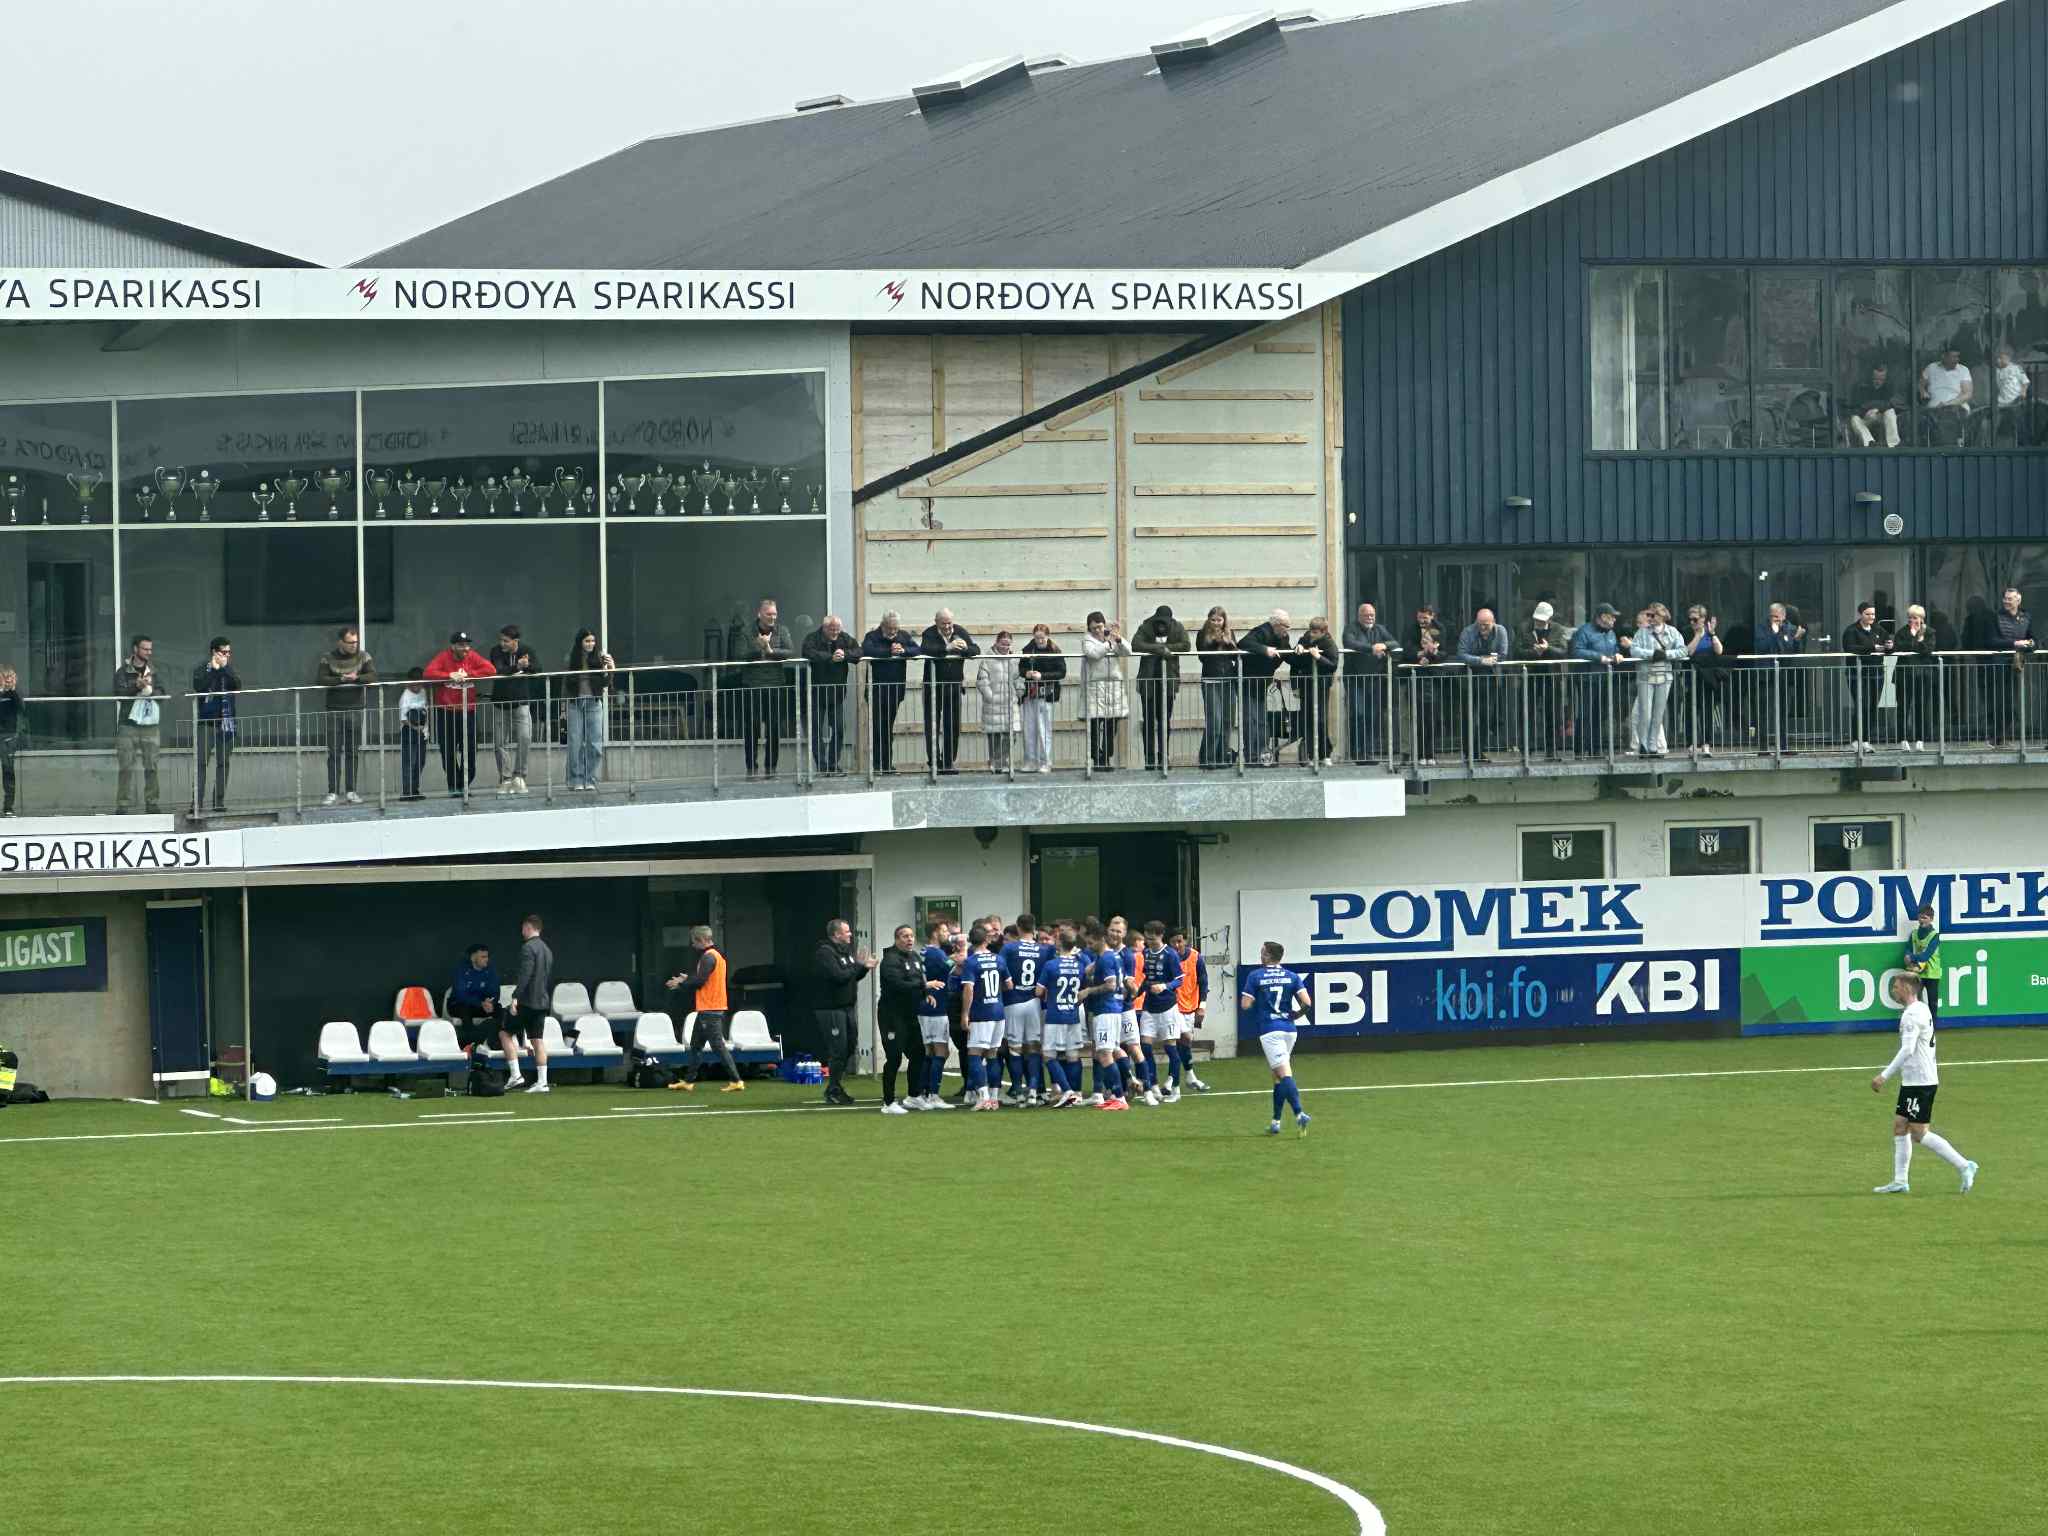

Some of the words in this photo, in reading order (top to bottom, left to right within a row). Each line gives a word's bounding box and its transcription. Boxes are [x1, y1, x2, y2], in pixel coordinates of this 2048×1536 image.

[49, 278, 261, 309] SPARIKASSI
[395, 280, 577, 310] NORÐOYA
[593, 281, 796, 310] SPARIKASSI
[921, 282, 1096, 311] NORÐOYA
[1111, 282, 1303, 311] SPARIKASSI
[0, 837, 211, 872] SPARIKASSI
[1309, 883, 1644, 953] POMEK
[0, 931, 75, 967] IGAST
[981, 970, 1000, 998] 10
[1021, 959, 1036, 986] 8
[1596, 959, 1720, 1015] KBI
[2031, 974, 2048, 986] Ba
[1056, 976, 1081, 1004] 23
[1269, 986, 1284, 1013] 7
[1435, 965, 1548, 1021] kbi.fo
[1906, 1097, 1920, 1113] 24
